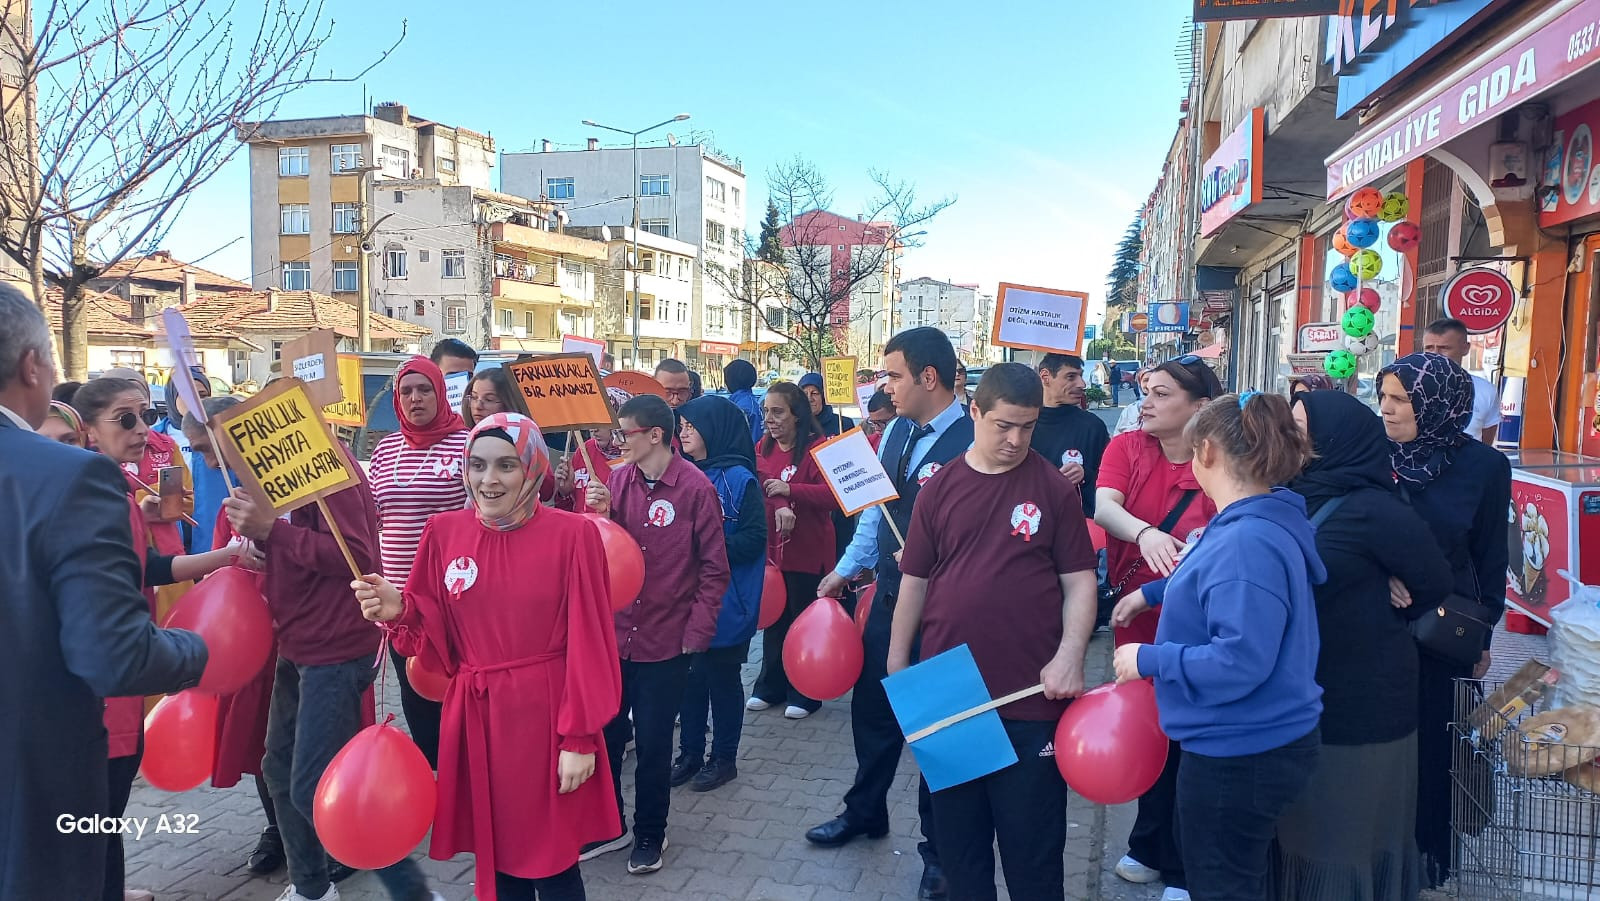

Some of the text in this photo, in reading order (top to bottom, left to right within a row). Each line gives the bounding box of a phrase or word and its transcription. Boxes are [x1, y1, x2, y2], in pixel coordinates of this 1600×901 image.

[1342, 47, 1536, 188] KEMALİYE GIDA
[523, 381, 597, 399] BİR ARADAYIZ
[228, 398, 307, 453] FARKLILIK
[245, 430, 312, 480] HAYATA
